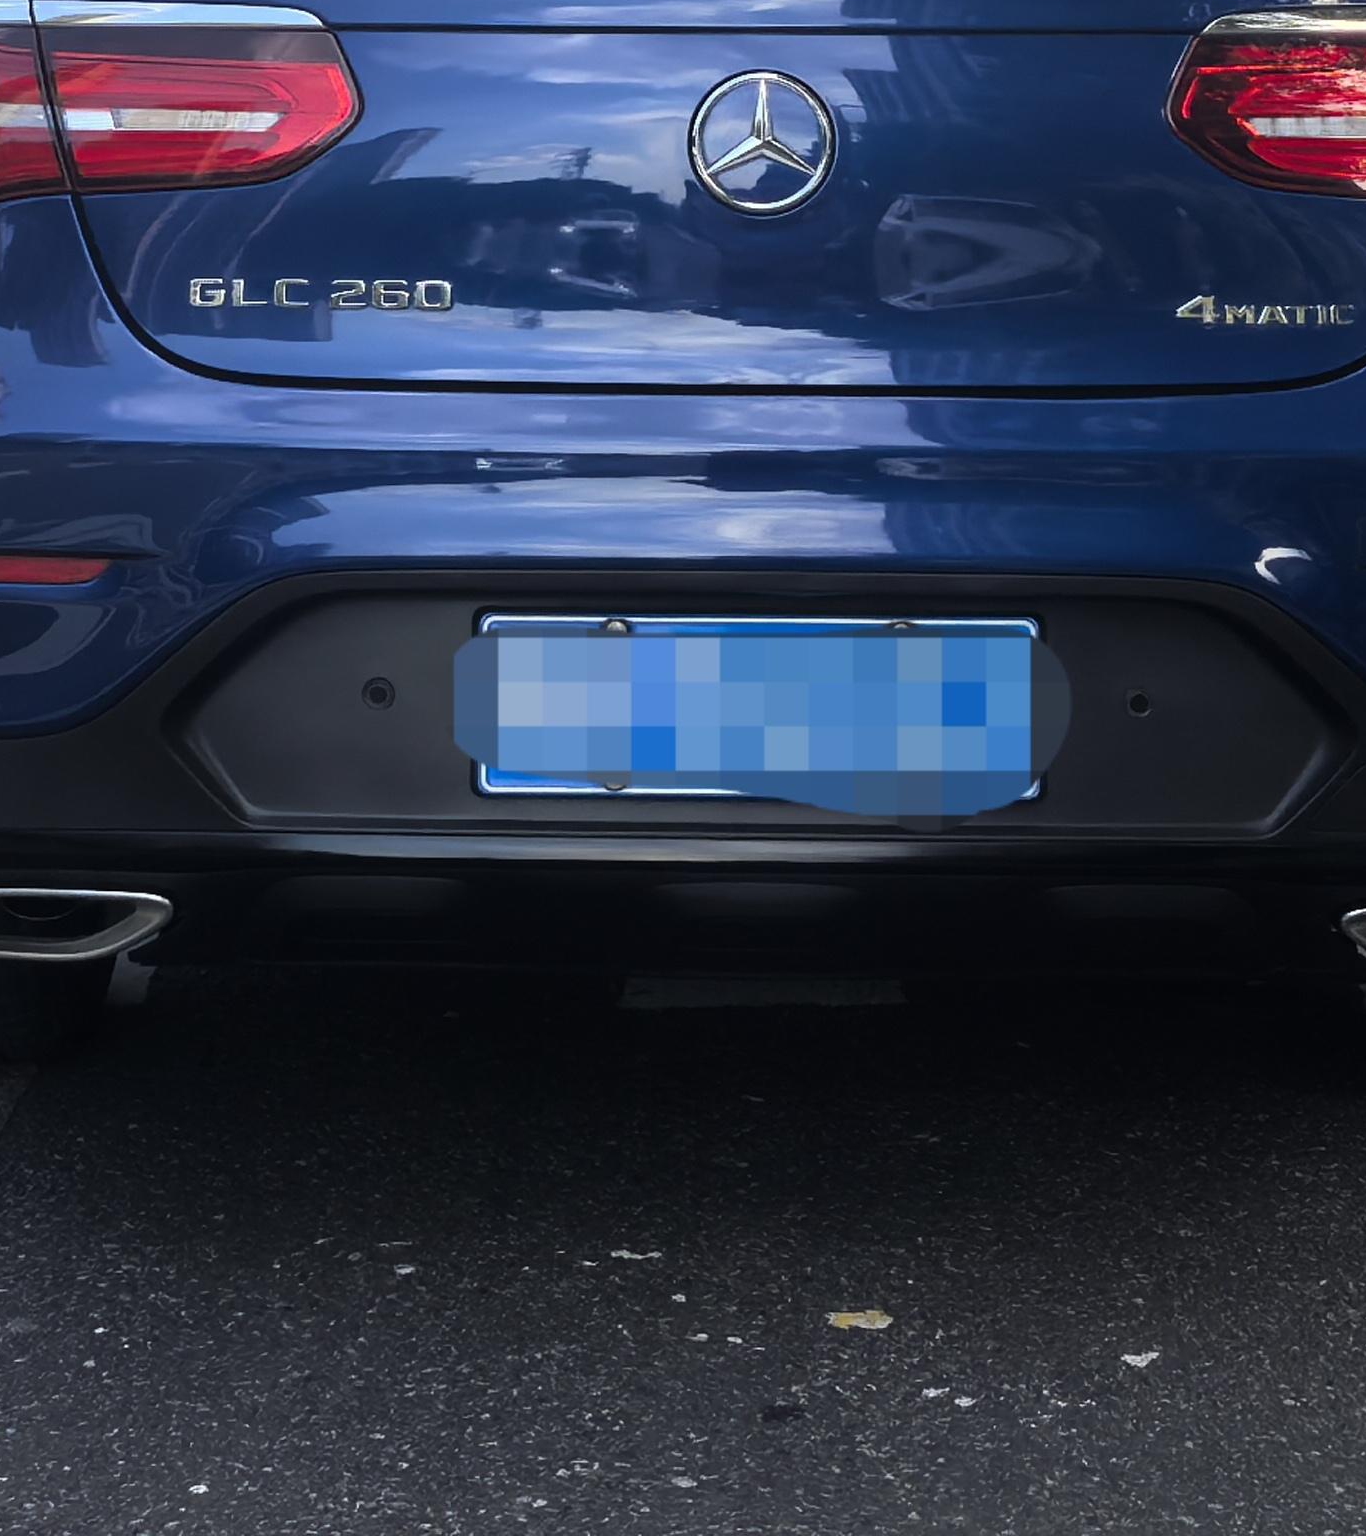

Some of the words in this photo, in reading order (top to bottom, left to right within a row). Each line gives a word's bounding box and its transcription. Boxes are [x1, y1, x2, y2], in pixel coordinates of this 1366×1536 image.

[189, 278, 311, 309] GLC
[330, 279, 454, 310] 260
[1175, 294, 1355, 326] 4MATIC
